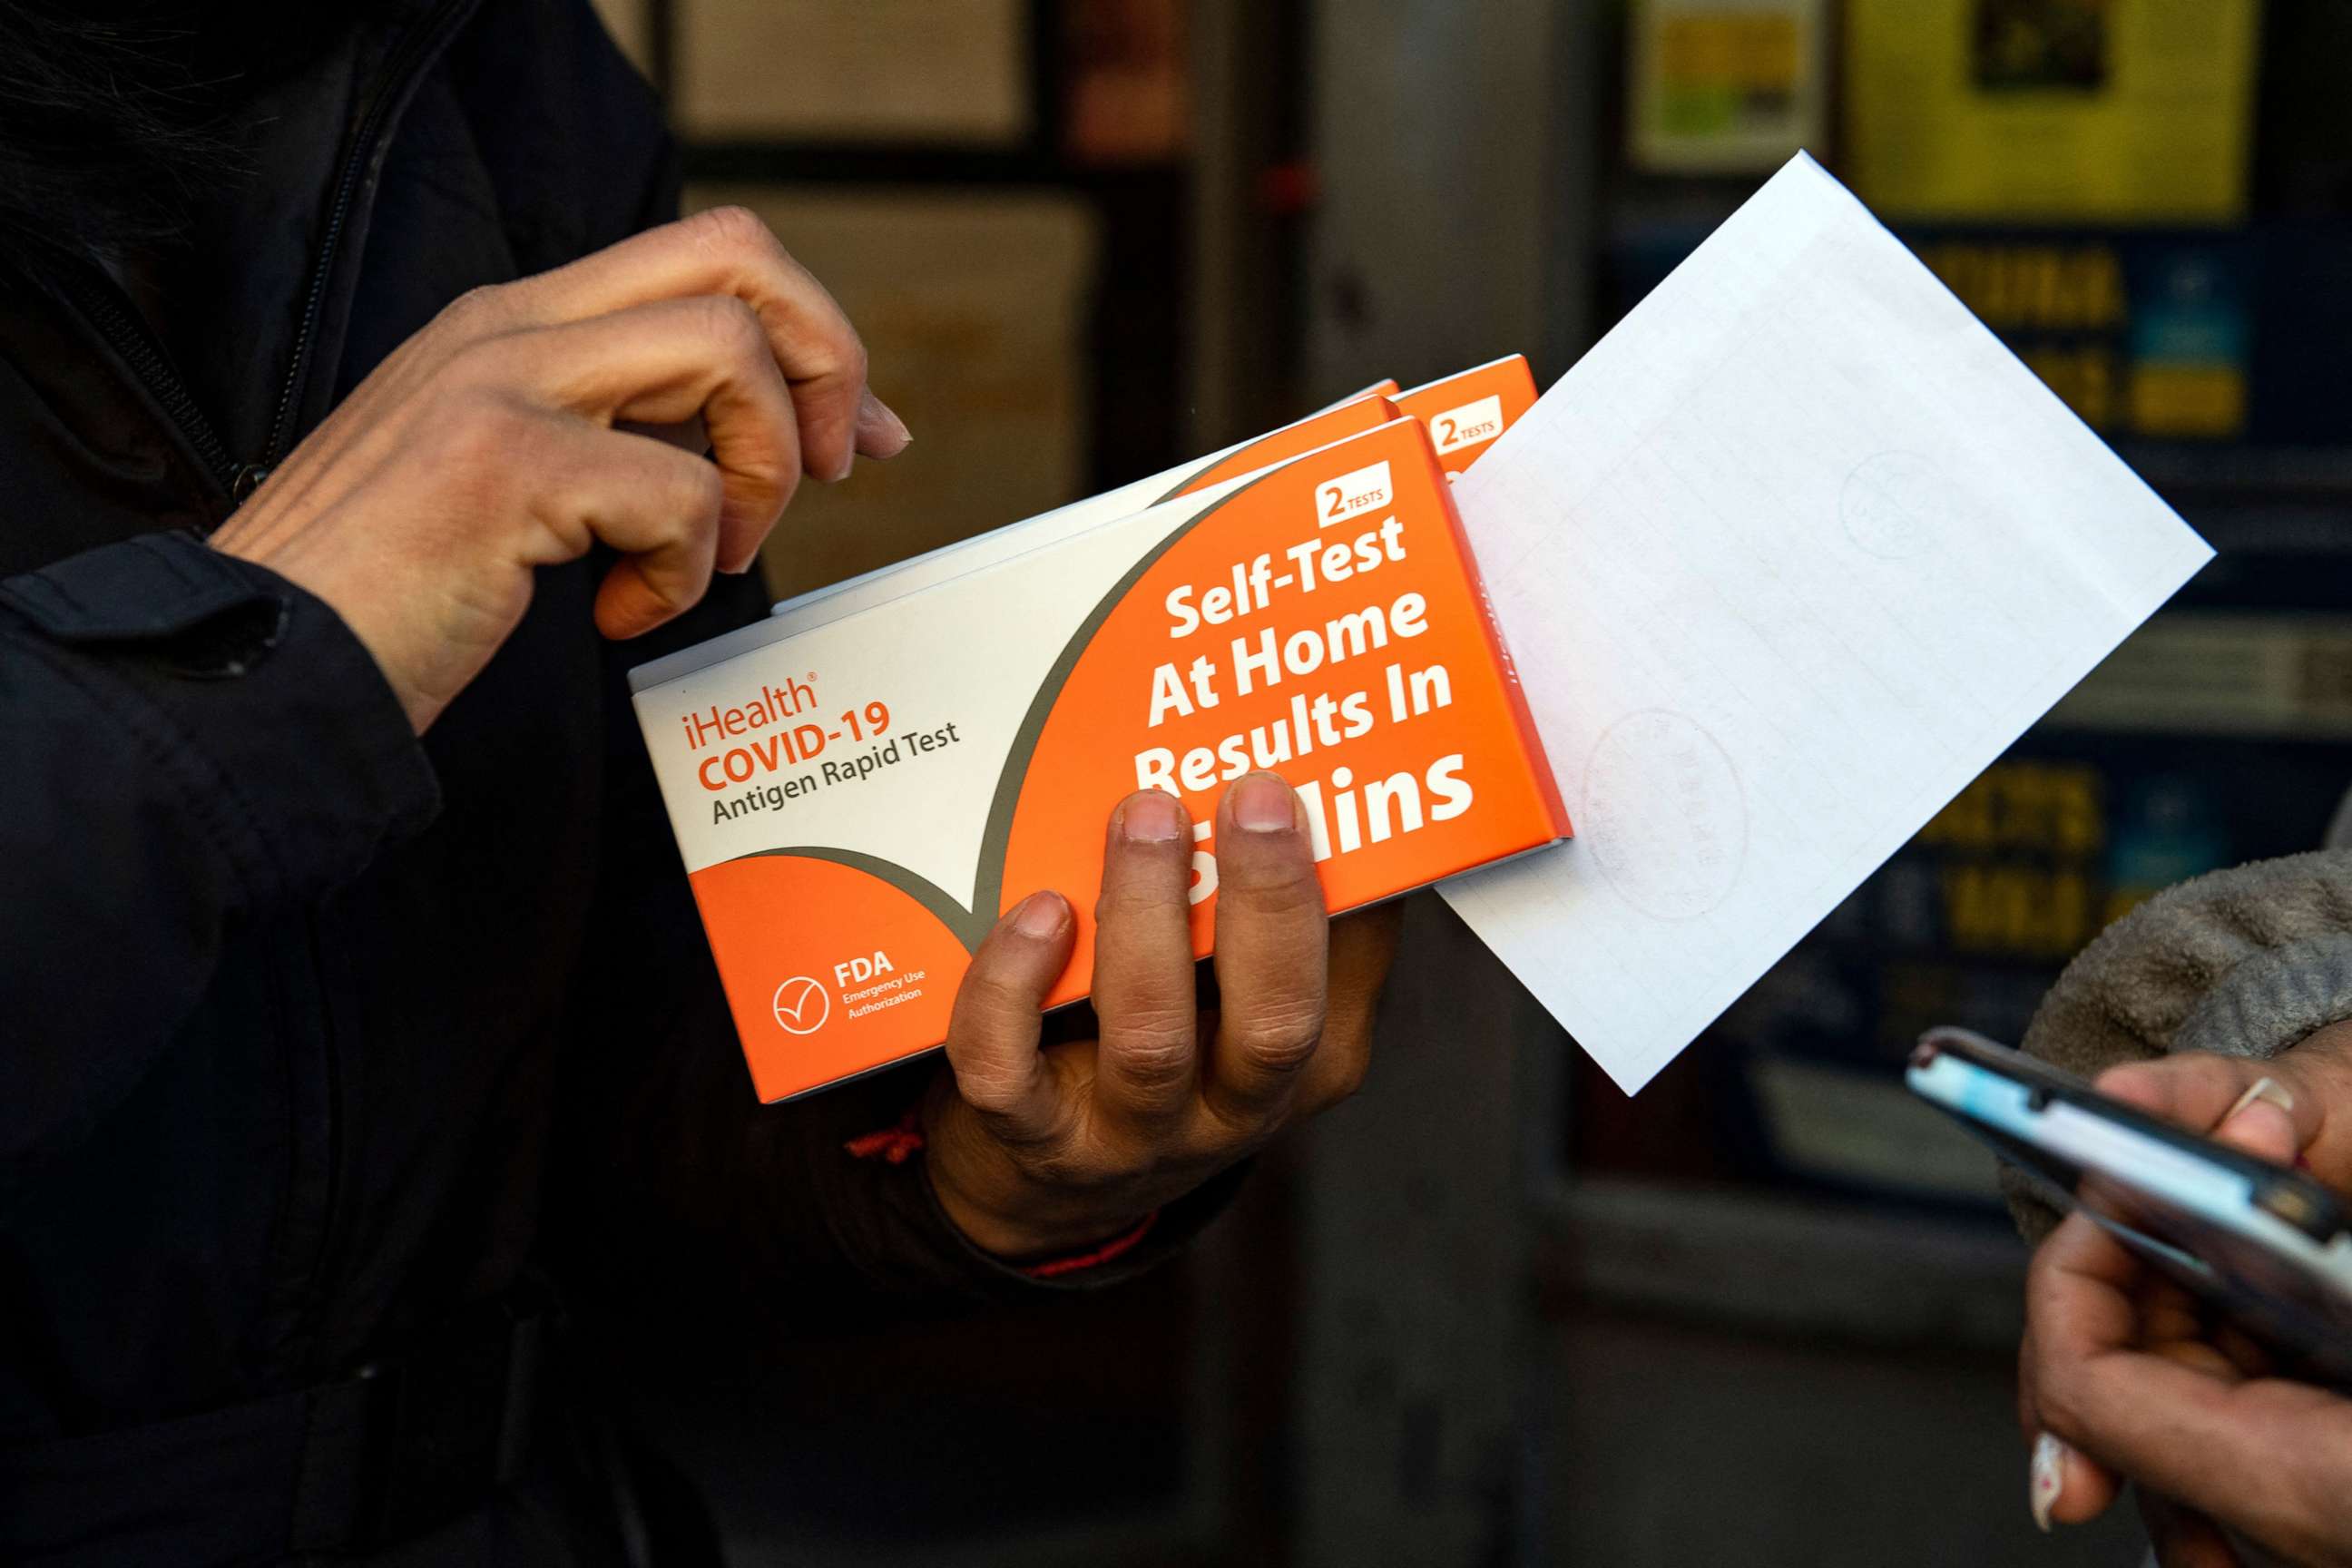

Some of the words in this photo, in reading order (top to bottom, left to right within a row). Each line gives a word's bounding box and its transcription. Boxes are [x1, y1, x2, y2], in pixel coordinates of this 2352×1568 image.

[1440, 418, 1458, 446] 2
[1461, 421, 1495, 440] TESTS
[1325, 486, 1346, 517] 2
[1348, 489, 1384, 509] TESTS
[1165, 515, 1406, 638] Self-Test
[1148, 655, 1220, 728] At
[1230, 592, 1428, 695] Home
[698, 701, 890, 791] COVID-19
[1134, 691, 1374, 799] Results
[1386, 662, 1452, 723] In
[713, 770, 818, 825] Antigen
[821, 740, 900, 786] Rapid
[901, 722, 960, 759] Test
[834, 951, 894, 988] FDA
[842, 977, 903, 1004] Emergency
[904, 970, 925, 984] Use
[848, 988, 922, 1019] Authorization
